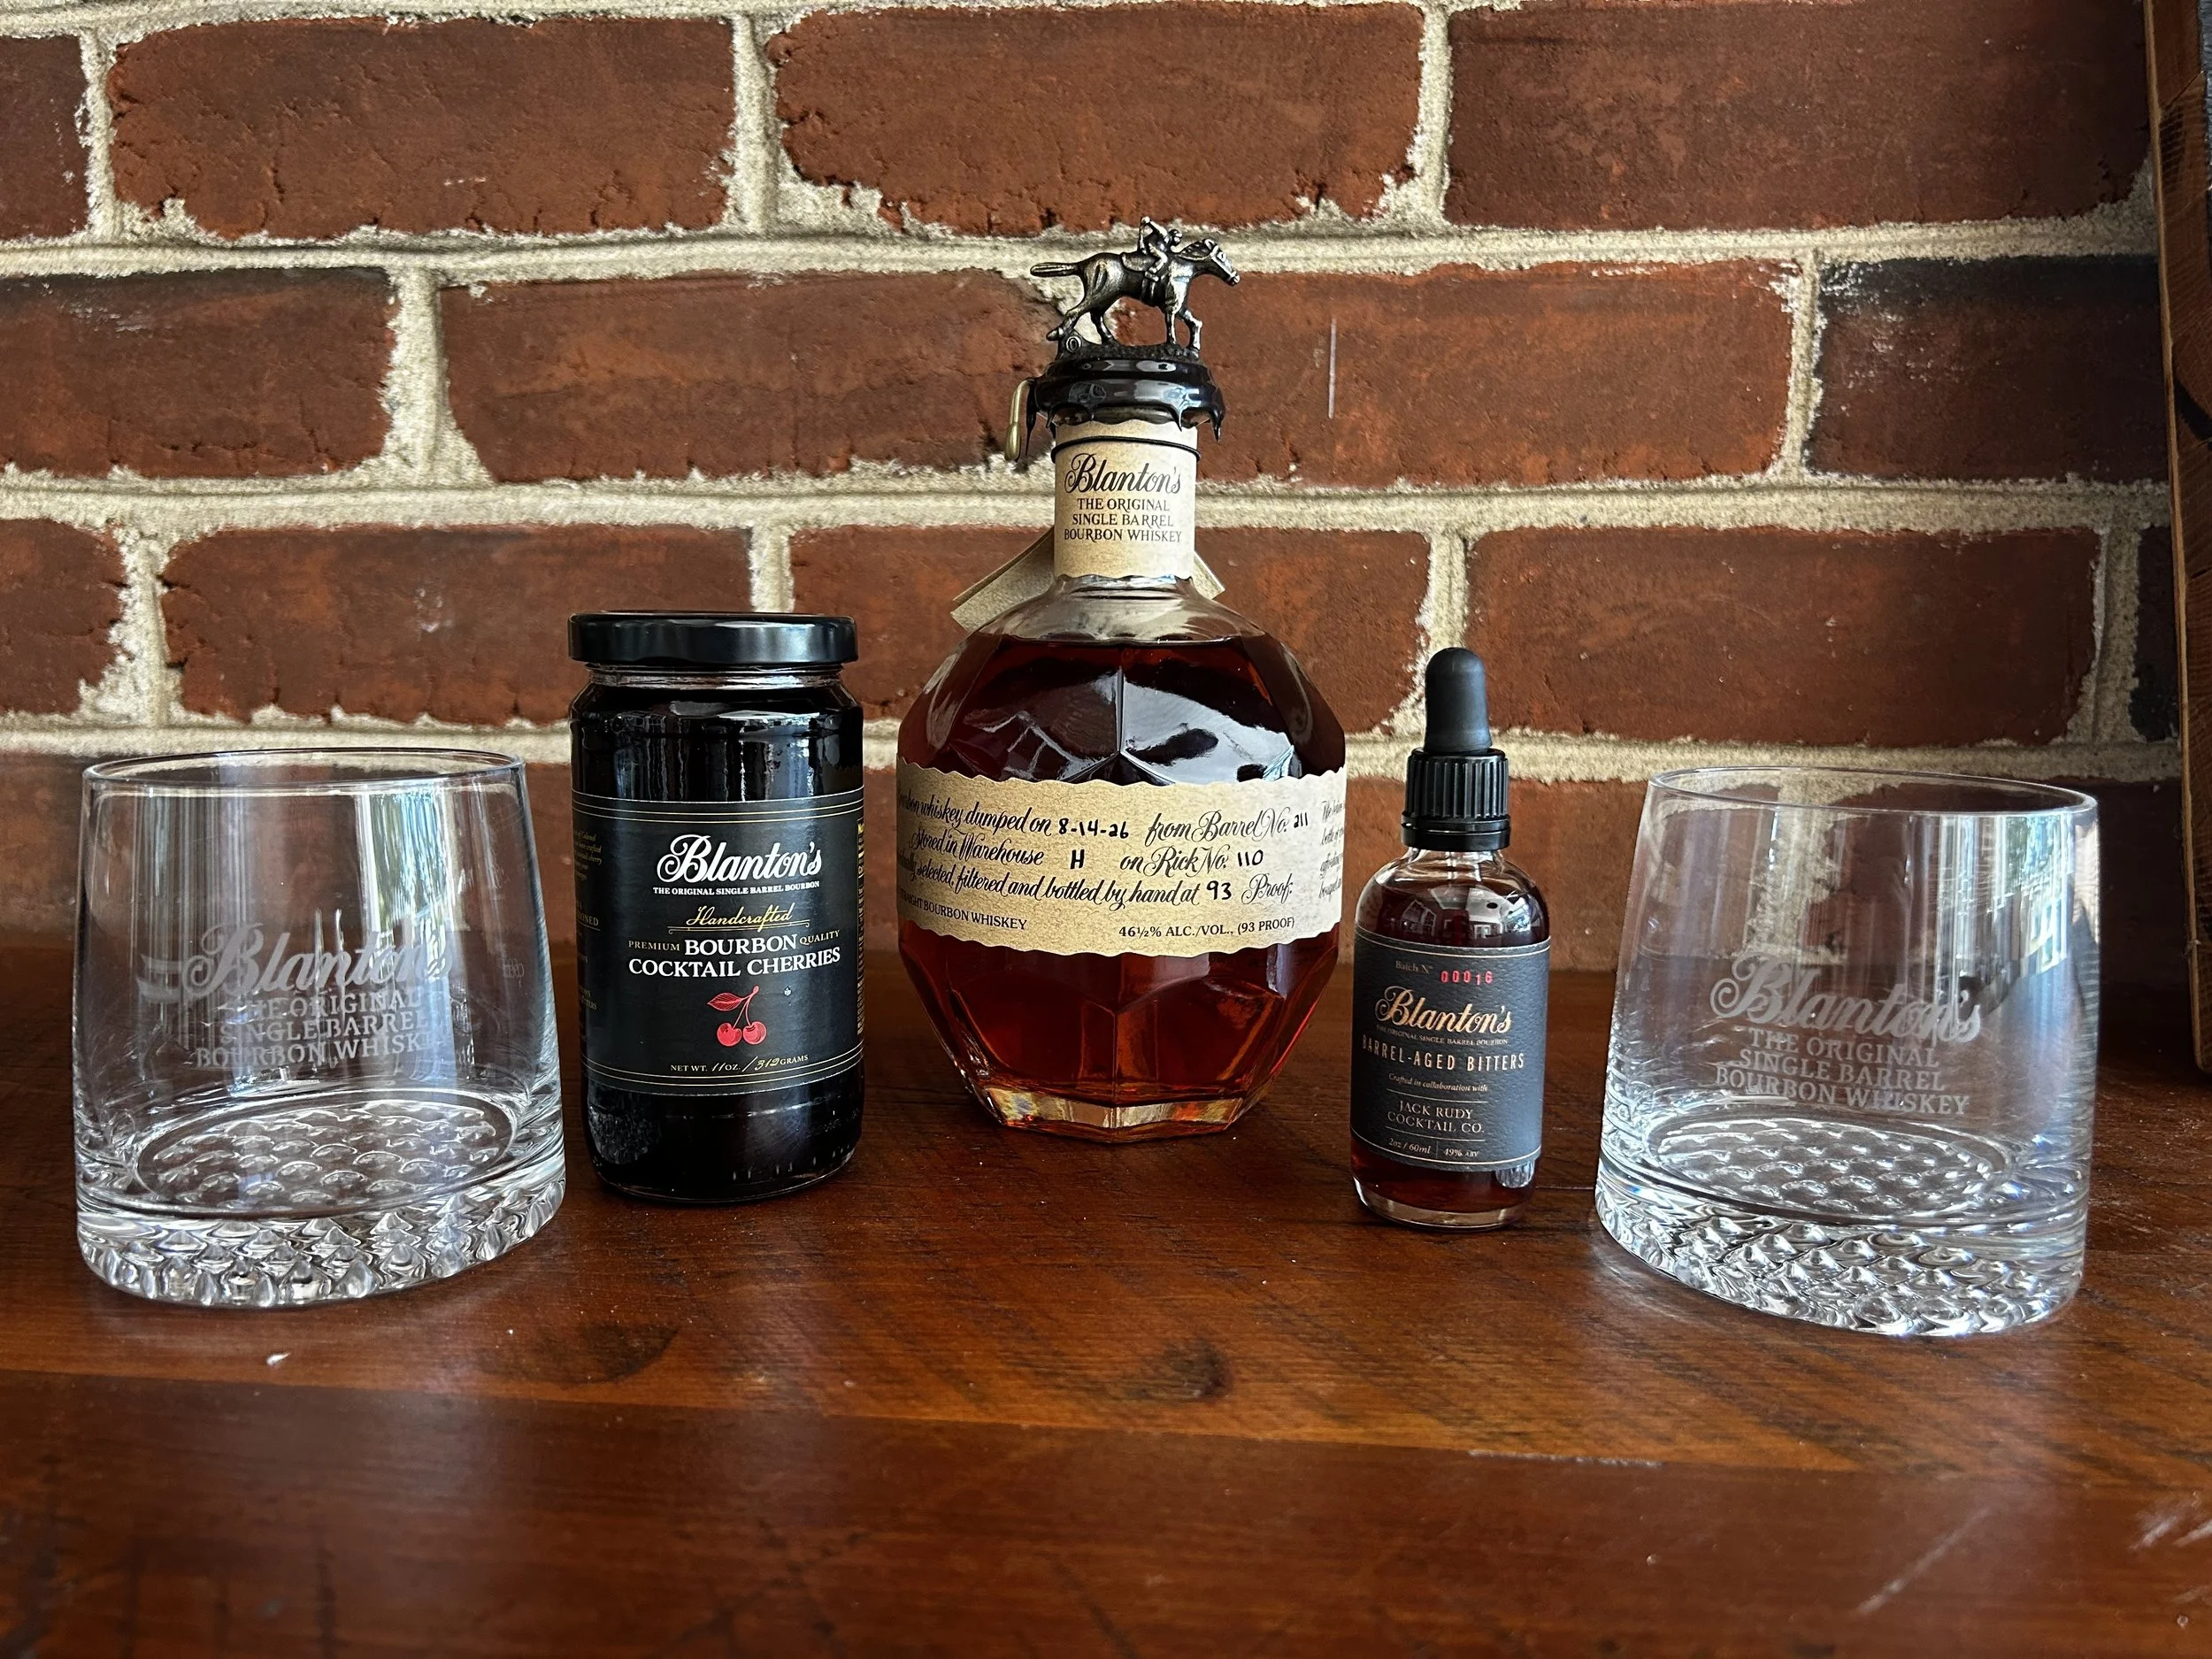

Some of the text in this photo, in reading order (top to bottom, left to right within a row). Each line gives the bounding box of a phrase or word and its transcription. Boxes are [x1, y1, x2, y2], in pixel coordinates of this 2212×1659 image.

[1064, 453, 1181, 494] Blanton's
[1078, 498, 1170, 512] THE ORIGINAL
[1064, 529, 1181, 542] BOURBON WHISKEY
[1072, 514, 1173, 529] SINGLE BARREL
[920, 795, 965, 832] whiskey
[964, 801, 1033, 835] dumped
[1029, 818, 1051, 836] on
[1058, 818, 1129, 839] 8-14-26
[1145, 812, 1192, 847] from
[1191, 809, 1263, 842] Barrel
[657, 834, 822, 883] Blanton's
[909, 823, 947, 855] Stored
[957, 832, 1044, 865] Warehouse
[1237, 849, 1263, 867] 110
[1070, 849, 1085, 870] H
[1119, 855, 1143, 873] on
[1142, 845, 1198, 878] Rick
[785, 881, 819, 891] BOURBON
[955, 865, 1010, 897] filtered
[1008, 876, 1043, 901] and
[1042, 876, 1102, 905] bottled
[1102, 879, 1127, 911] by
[1125, 879, 1181, 906] hand
[1179, 883, 1201, 906] at
[1206, 880, 1232, 901] 93
[686, 902, 795, 933] Handcrafted
[924, 901, 969, 921] BOURBON
[972, 912, 1027, 930] WHISKEY
[1238, 922, 1255, 936] (93
[1258, 917, 1294, 931] PROOF)
[629, 930, 841, 956] PREMIUM BOURBON QUALITY
[629, 947, 841, 977] COCKTAIL CHERRIES
[1395, 960, 1418, 972] Batch
[1440, 970, 1494, 986] 00016
[290, 985, 421, 1018] ORIGINAL
[1375, 986, 1511, 1033] Blanton's
[1709, 950, 1982, 1043] Blanton's
[327, 1010, 429, 1039] BARREL
[1387, 1027, 1417, 1041] ORIGINAL
[196, 1031, 434, 1069] BOURBON WHISK
[1363, 1034, 1525, 1071] BARREL-AGED BITTERS
[1748, 1026, 1939, 1068] THE ORIGINAL
[1388, 1072, 1412, 1086] Crafted
[1422, 1079, 1471, 1092] collaboration
[1740, 1049, 1946, 1093] SINGLE BARREL
[1716, 1065, 1970, 1116] BOURBON WHISKEY
[1387, 1111, 1485, 1133] COCKTAIL CO.
[1399, 1100, 1473, 1119] JACK RUDY
